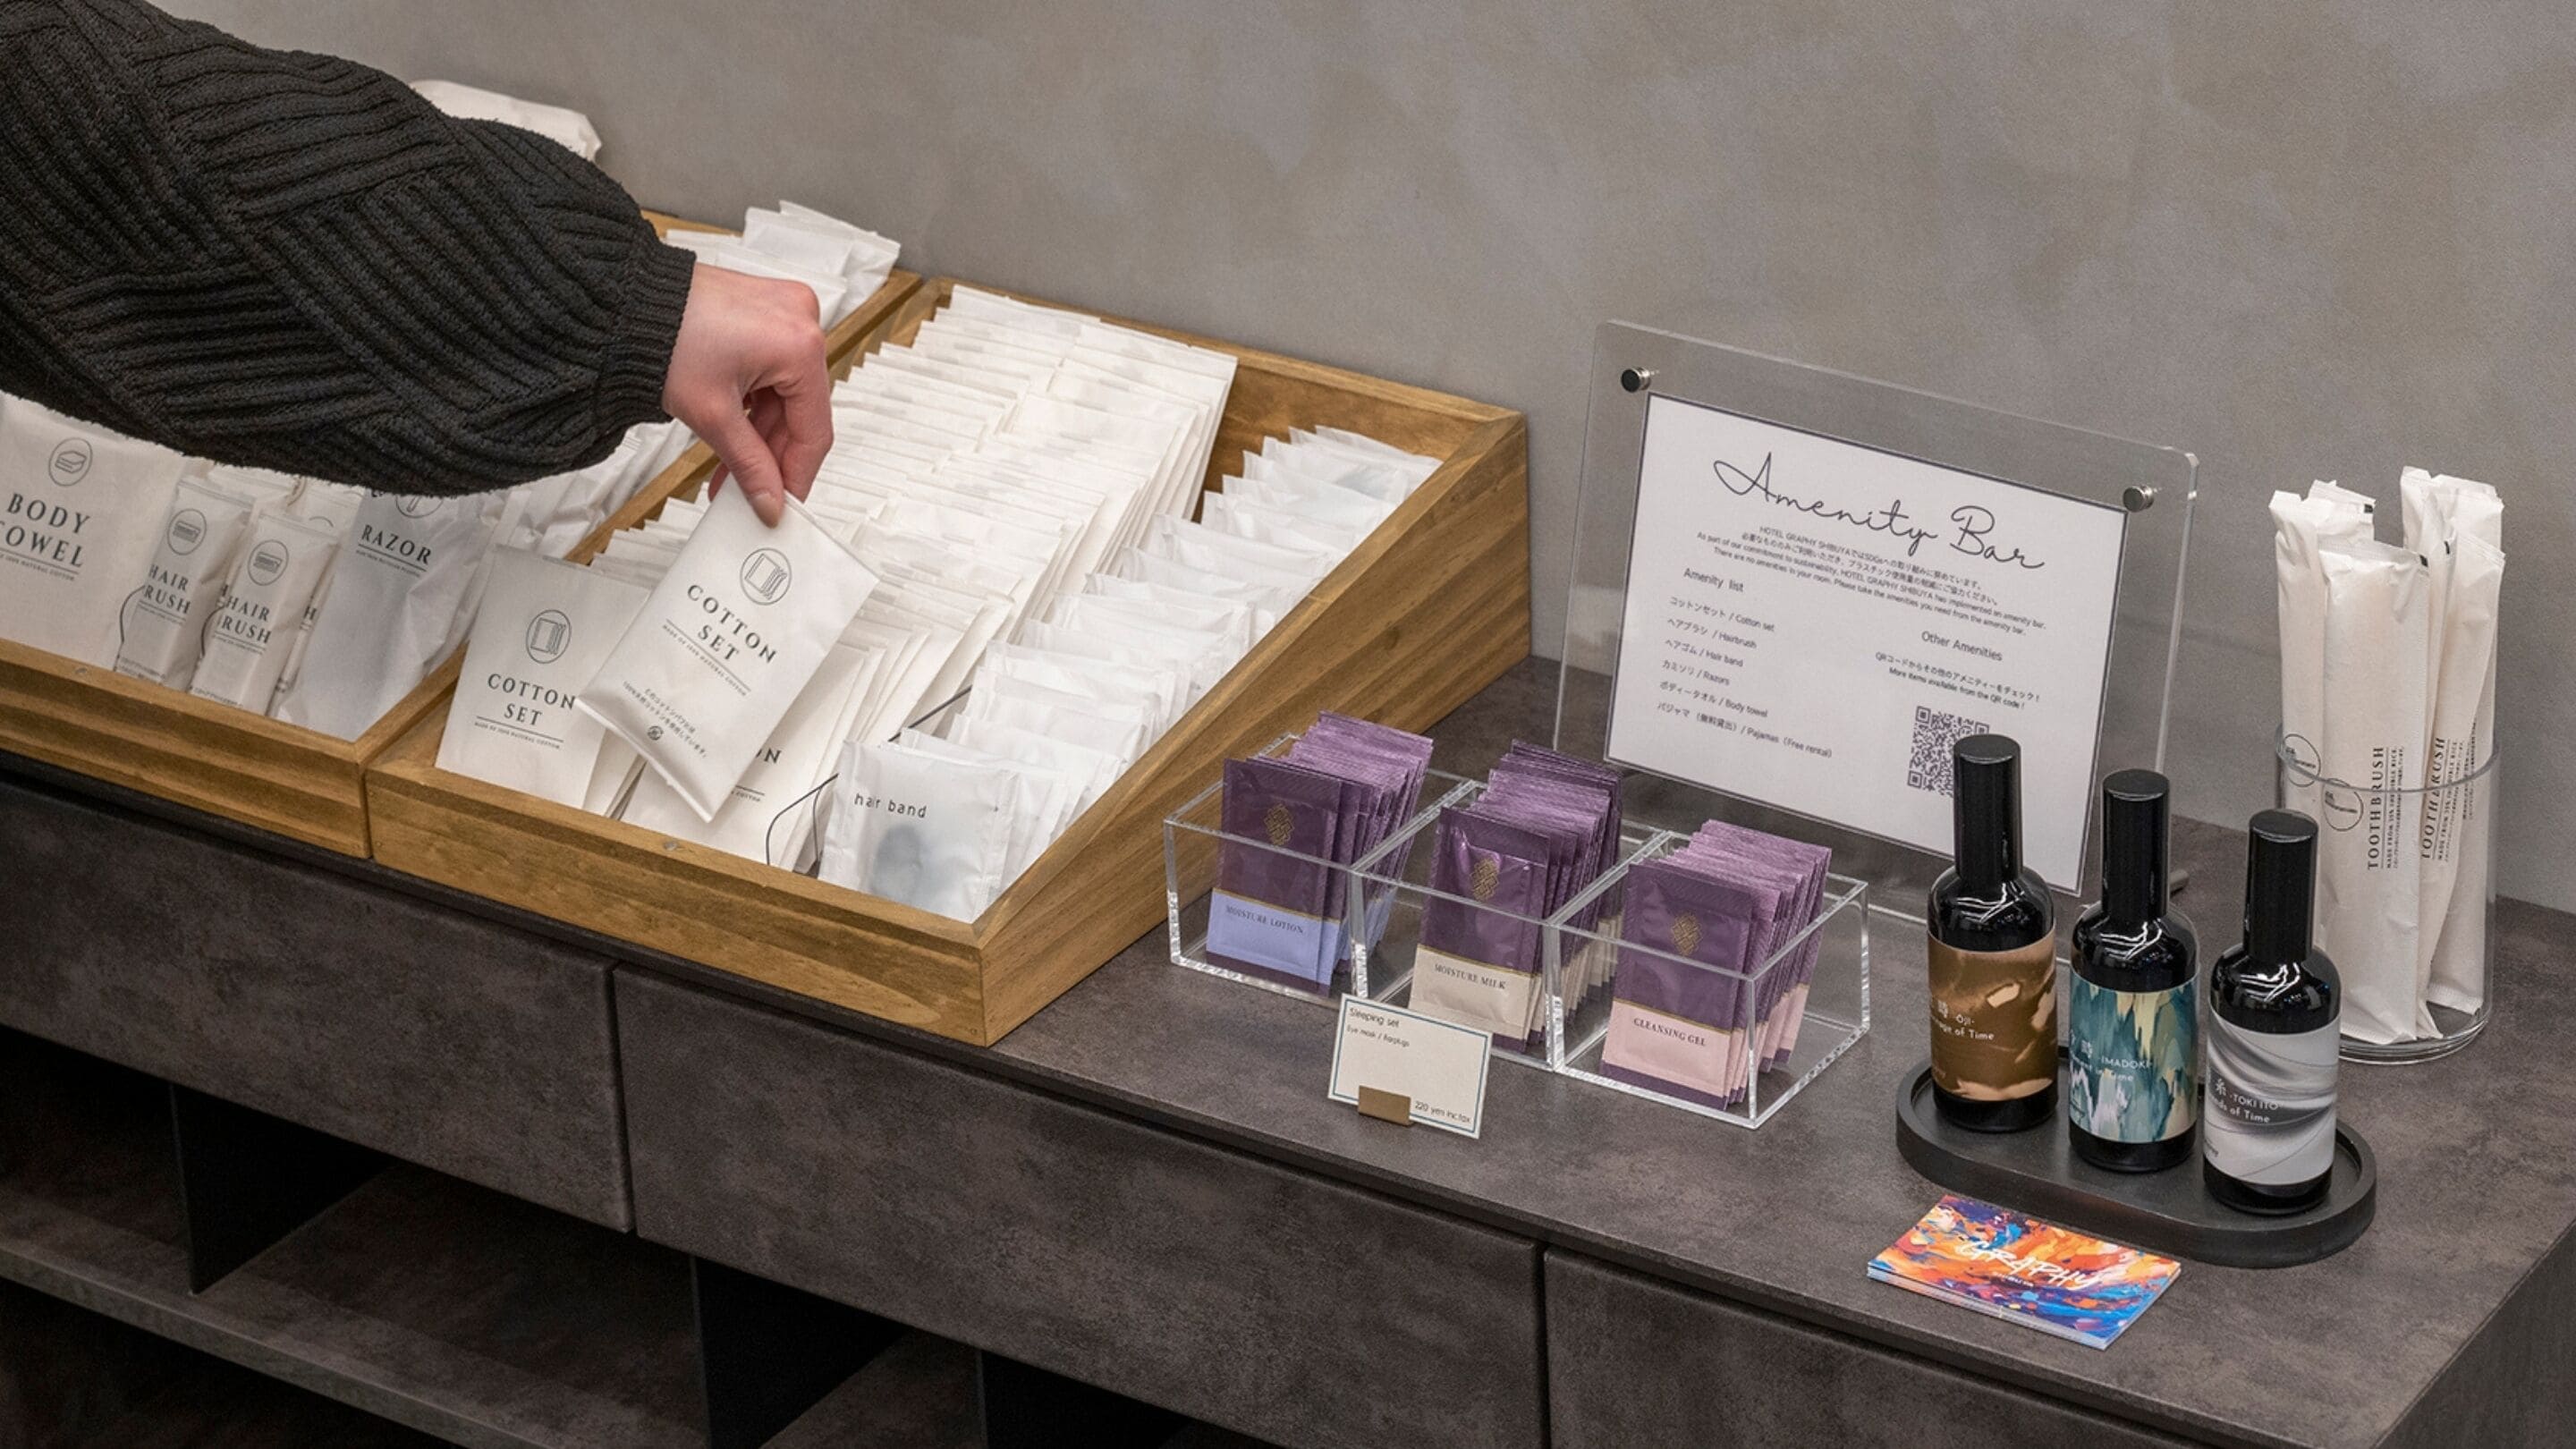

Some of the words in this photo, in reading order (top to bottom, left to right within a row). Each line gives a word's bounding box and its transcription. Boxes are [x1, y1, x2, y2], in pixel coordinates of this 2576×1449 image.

[8, 493, 90, 534] BODY
[1713, 452, 1938, 556] Amenity
[1950, 505, 2045, 569] Bar
[361, 524, 431, 564] RAZOR
[148, 564, 189, 590] HAIR
[1683, 568, 1724, 589] Amenity
[1728, 580, 1744, 592] list
[1714, 547, 1733, 557] There
[1858, 585, 1873, 594] take
[1874, 589, 1885, 597] the
[1935, 606, 1951, 614] need
[1953, 611, 1970, 620] from
[144, 584, 191, 614] RUSH
[225, 596, 270, 621] HAIR
[221, 615, 272, 644] RUSH
[688, 584, 776, 664] COTTON
[1735, 614, 1761, 627] Cotton
[698, 624, 740, 660] SET
[1921, 631, 1950, 647] Other
[1953, 640, 2004, 661] Amenities
[1706, 650, 1722, 660] Hair
[1724, 656, 1744, 666] band
[487, 674, 576, 710] COTTON
[1724, 699, 1744, 713] Body
[504, 703, 542, 725] SET
[888, 800, 927, 818] band
[2368, 747, 2384, 870] TOOTHBRUSH
[1226, 904, 1267, 923] MOISTURE
[1270, 919, 1303, 933] LOTION
[1435, 964, 1478, 982] MOISTURE
[1481, 977, 1506, 989] MILK
[1350, 1007, 1385, 1026] Sleeping
[1387, 1018, 1400, 1028] set
[1634, 1018, 1686, 1040] CLEANSING
[1688, 1034, 1706, 1046] GEL
[1954, 1027, 1965, 1037] of
[1969, 1029, 1995, 1040] Time
[2230, 1106, 2240, 1115] of
[2244, 1109, 2270, 1123] Time
[1954, 1241, 2104, 1291] GRAPHY
